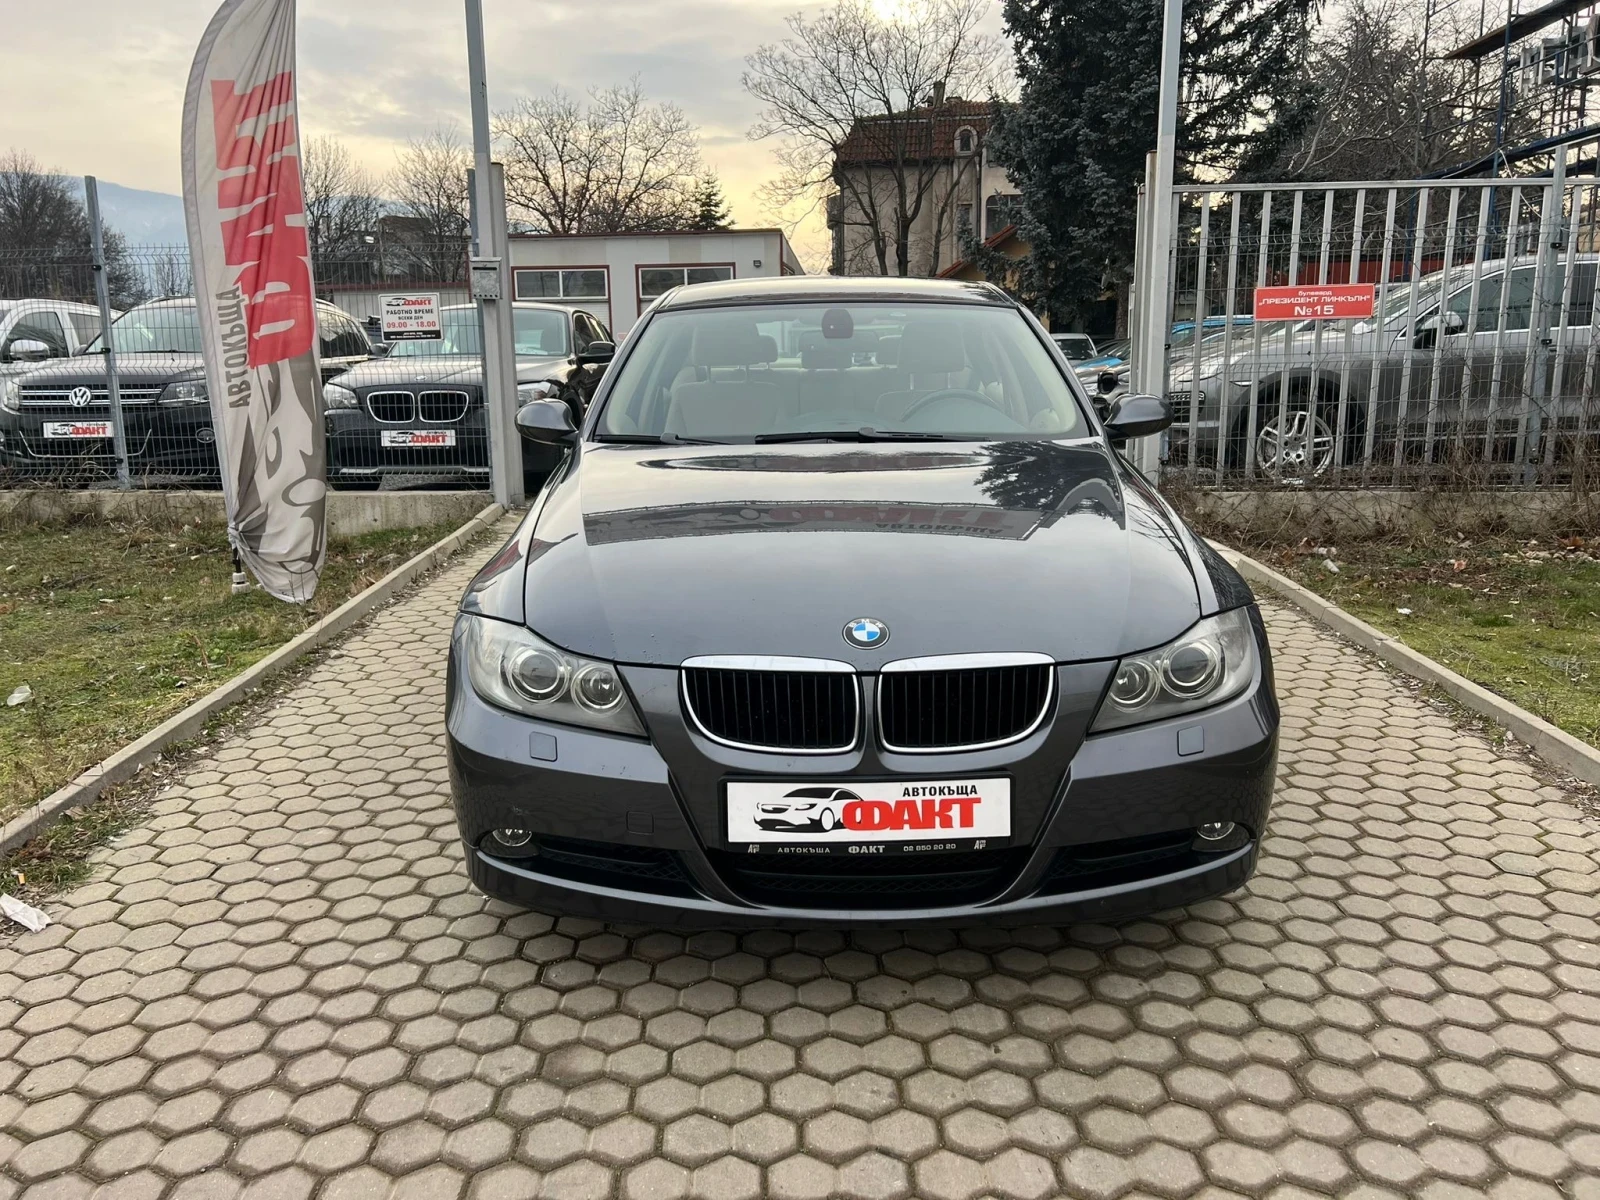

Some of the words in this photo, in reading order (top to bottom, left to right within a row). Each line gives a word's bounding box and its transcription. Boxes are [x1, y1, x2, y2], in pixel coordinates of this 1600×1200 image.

[211, 71, 314, 369] ФАКТ
[216, 285, 251, 409] АВТОКЪЩА
[902, 785, 978, 798] АВТОКЪЩА
[842, 797, 982, 831] ФАКТ
[848, 845, 885, 854] ФАКТ
